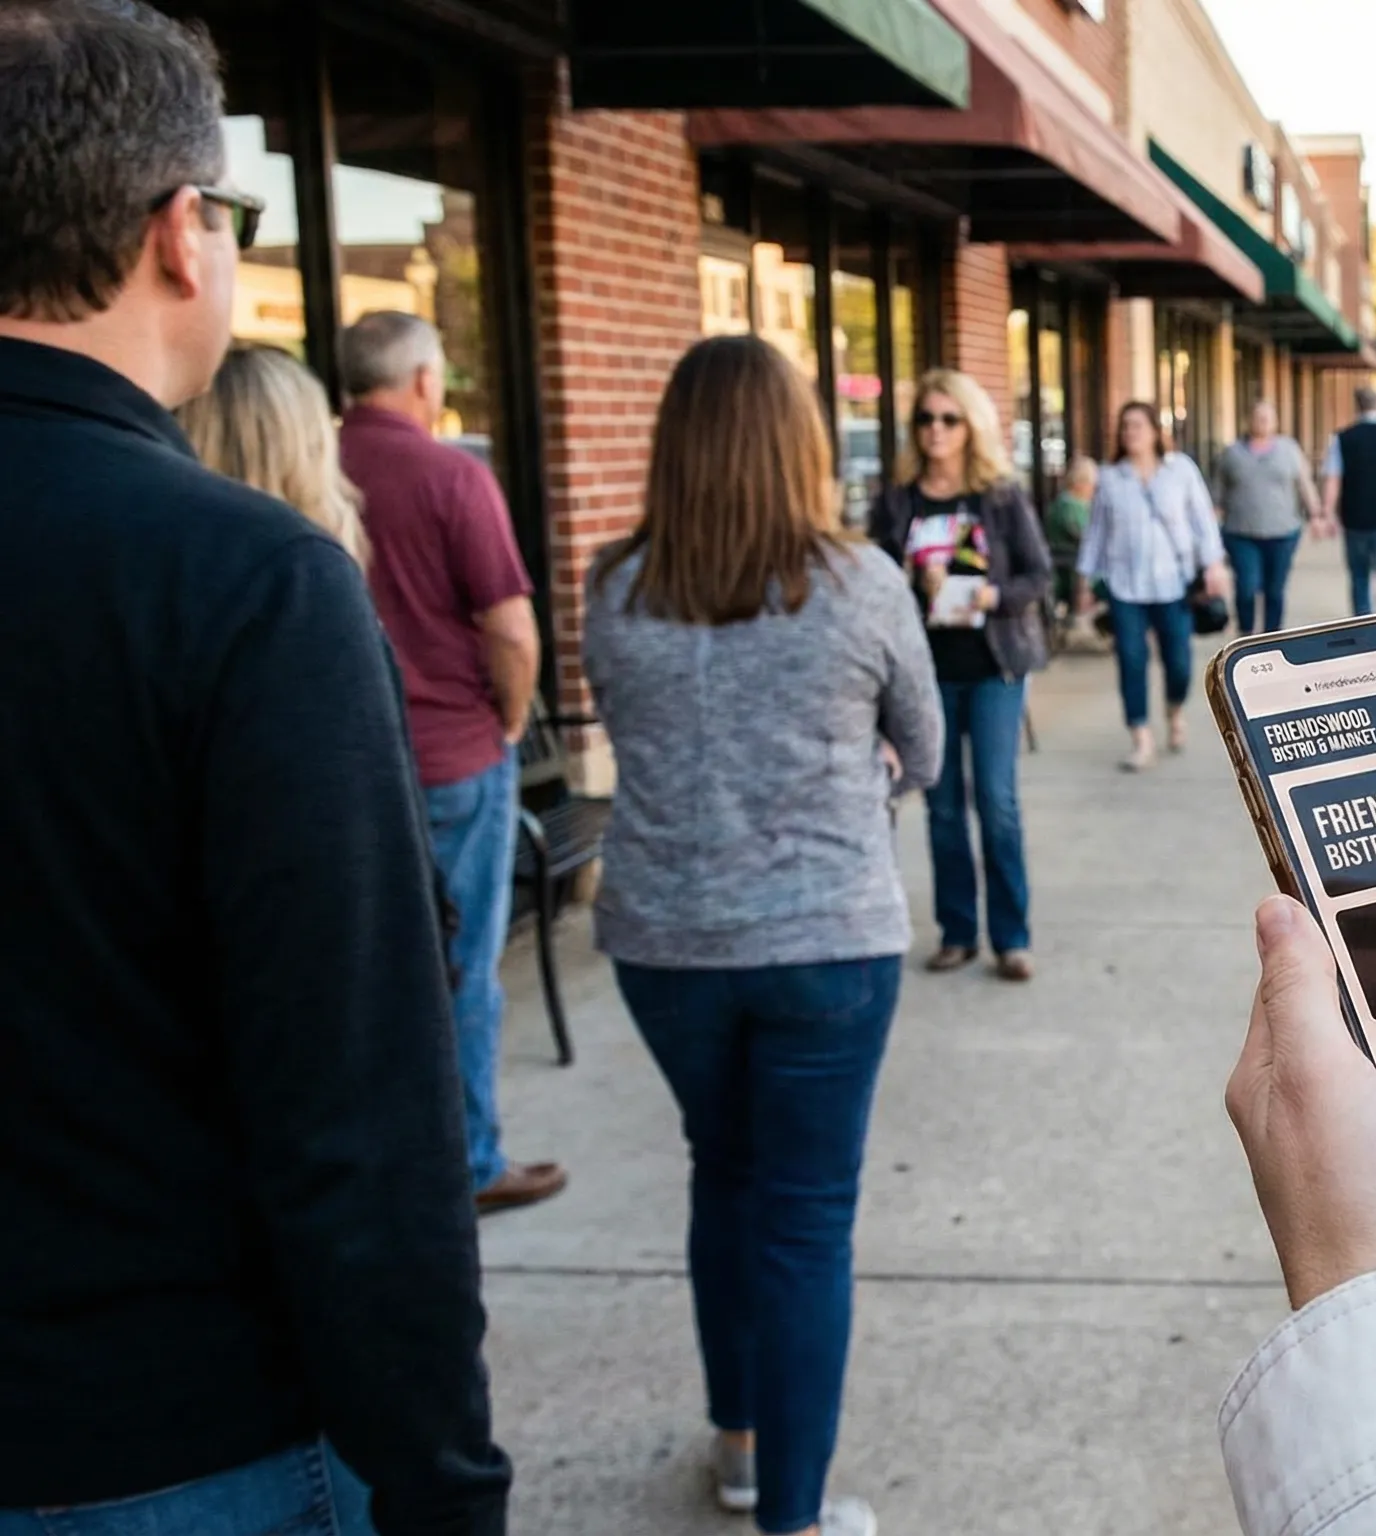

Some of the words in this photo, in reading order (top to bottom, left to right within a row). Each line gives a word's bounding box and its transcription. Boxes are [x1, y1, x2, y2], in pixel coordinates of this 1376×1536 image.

[1263, 708, 1371, 745] FRIENDSWOOD
[1271, 740, 1317, 763] BISTRO
[1316, 738, 1328, 754] &
